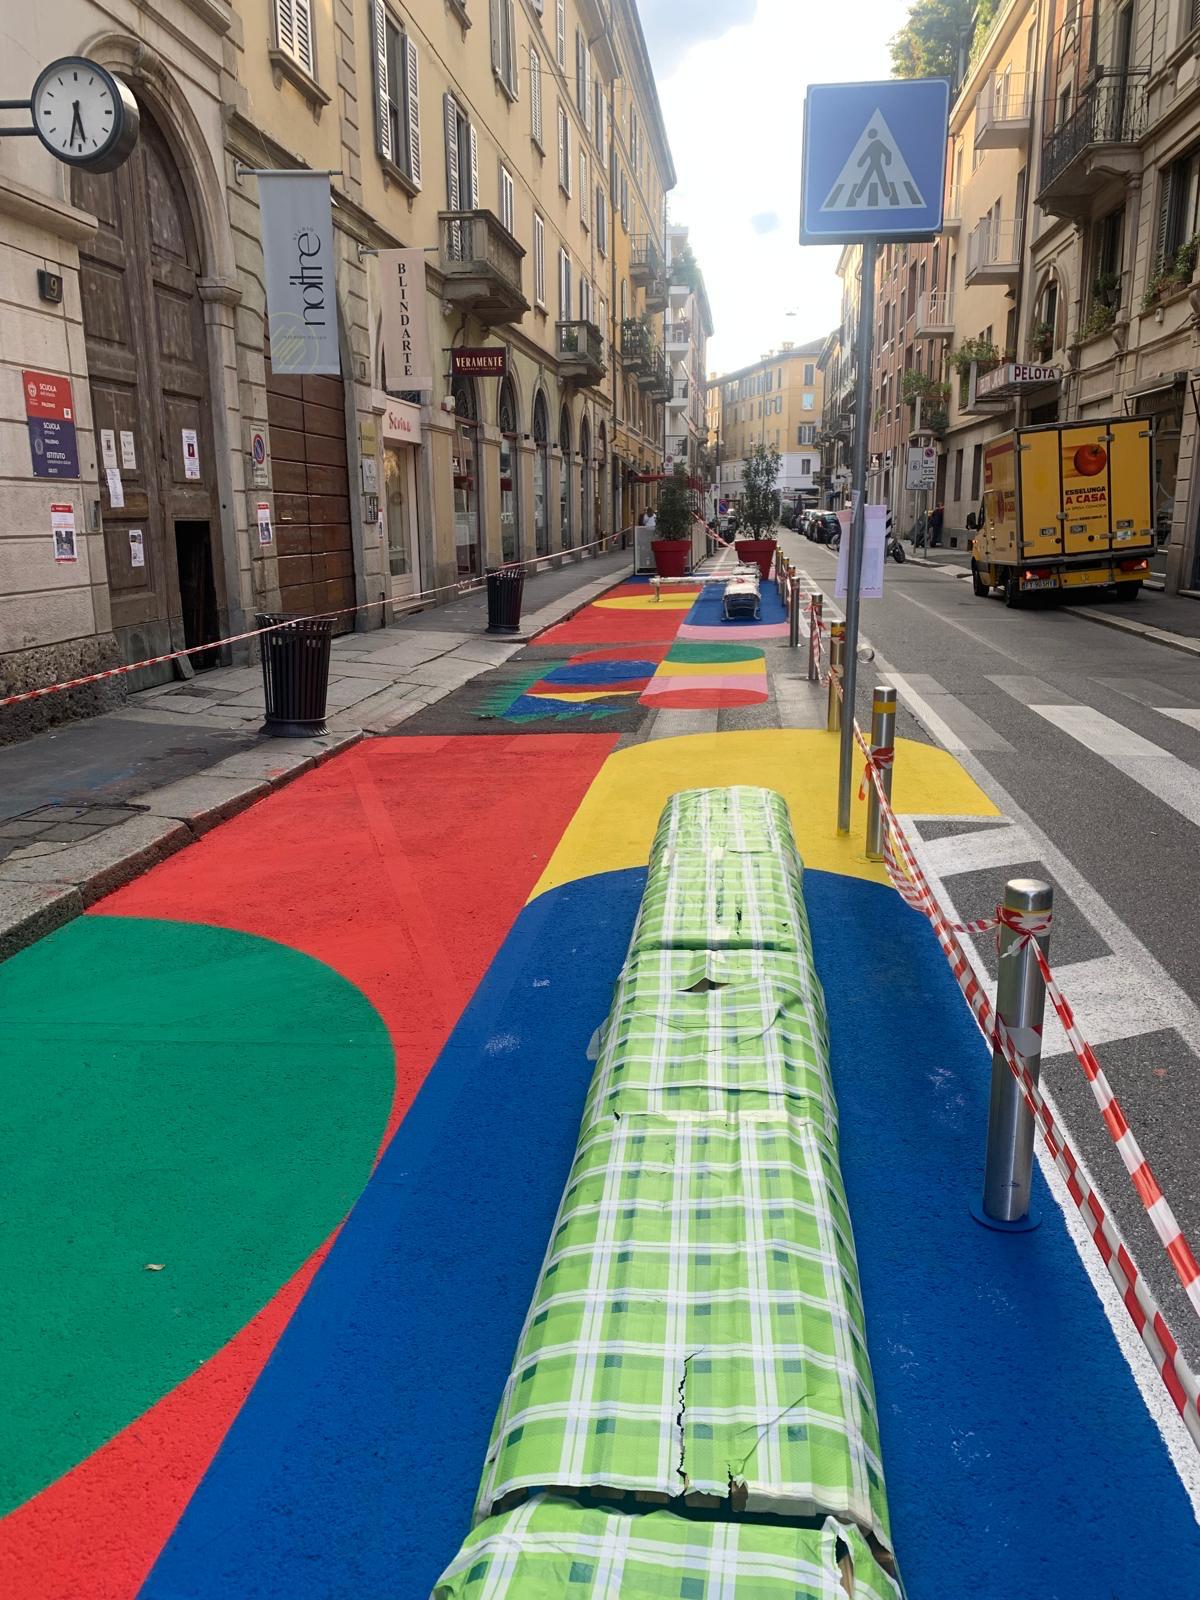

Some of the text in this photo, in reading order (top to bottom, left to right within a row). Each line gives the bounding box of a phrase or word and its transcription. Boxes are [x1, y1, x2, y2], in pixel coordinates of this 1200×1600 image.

[397, 262, 414, 376] BLINDARTE
[455, 356, 503, 368] VERAMENTE
[1014, 365, 1056, 381] PELOTA
[39, 383, 57, 393] SCUOLA
[43, 422, 61, 431] SCUOLA
[1065, 486, 1106, 496] ESSELUNGA
[1065, 493, 1107, 505] A CASA
